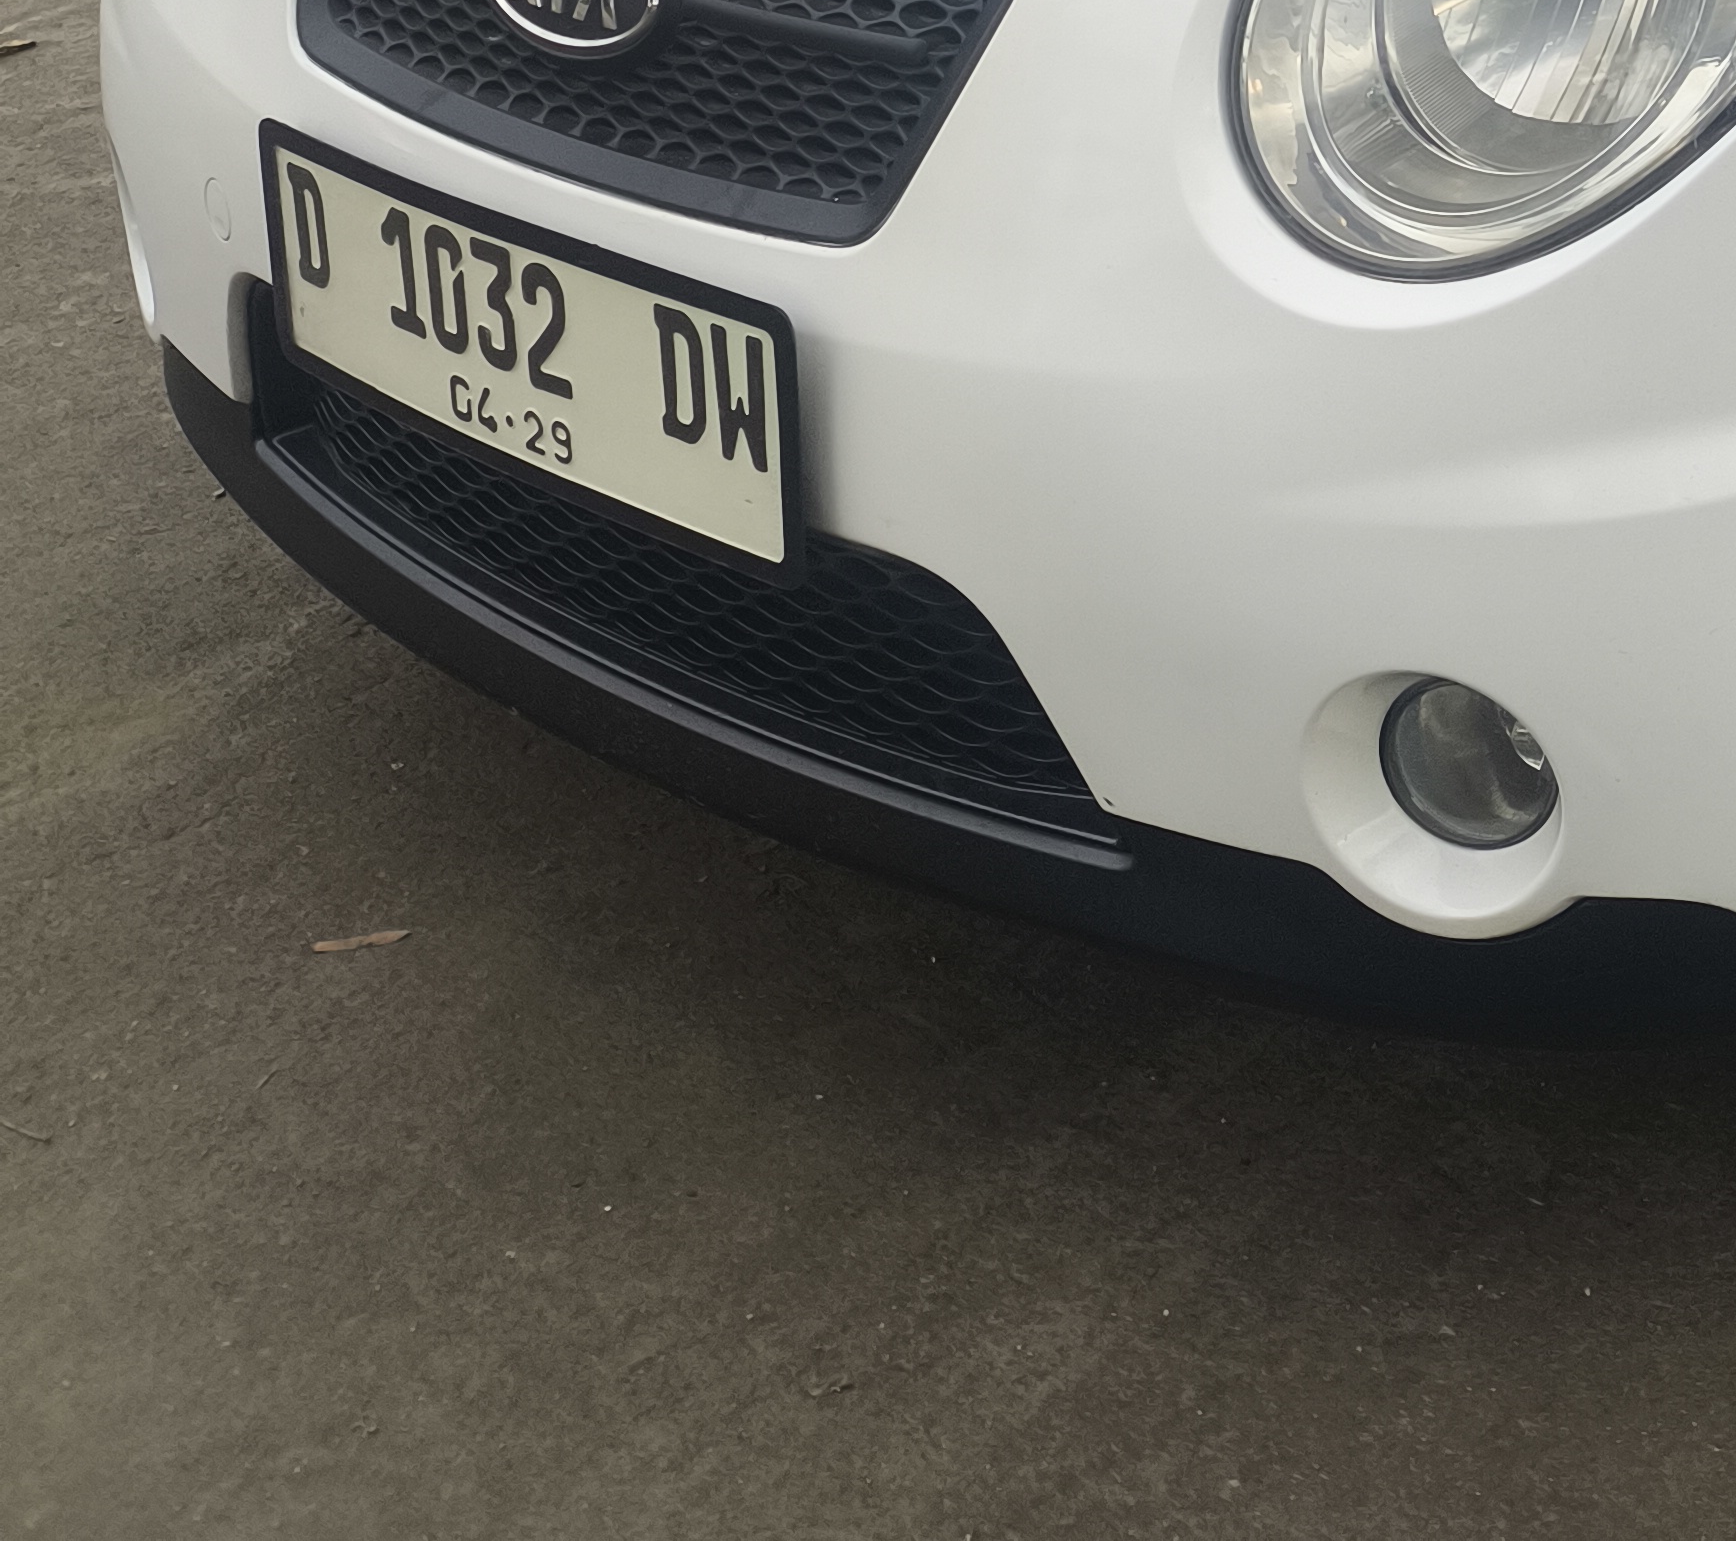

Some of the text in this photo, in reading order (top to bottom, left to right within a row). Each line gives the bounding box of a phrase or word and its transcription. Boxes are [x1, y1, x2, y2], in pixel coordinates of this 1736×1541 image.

[286, 161, 770, 474] D 1032 DW
